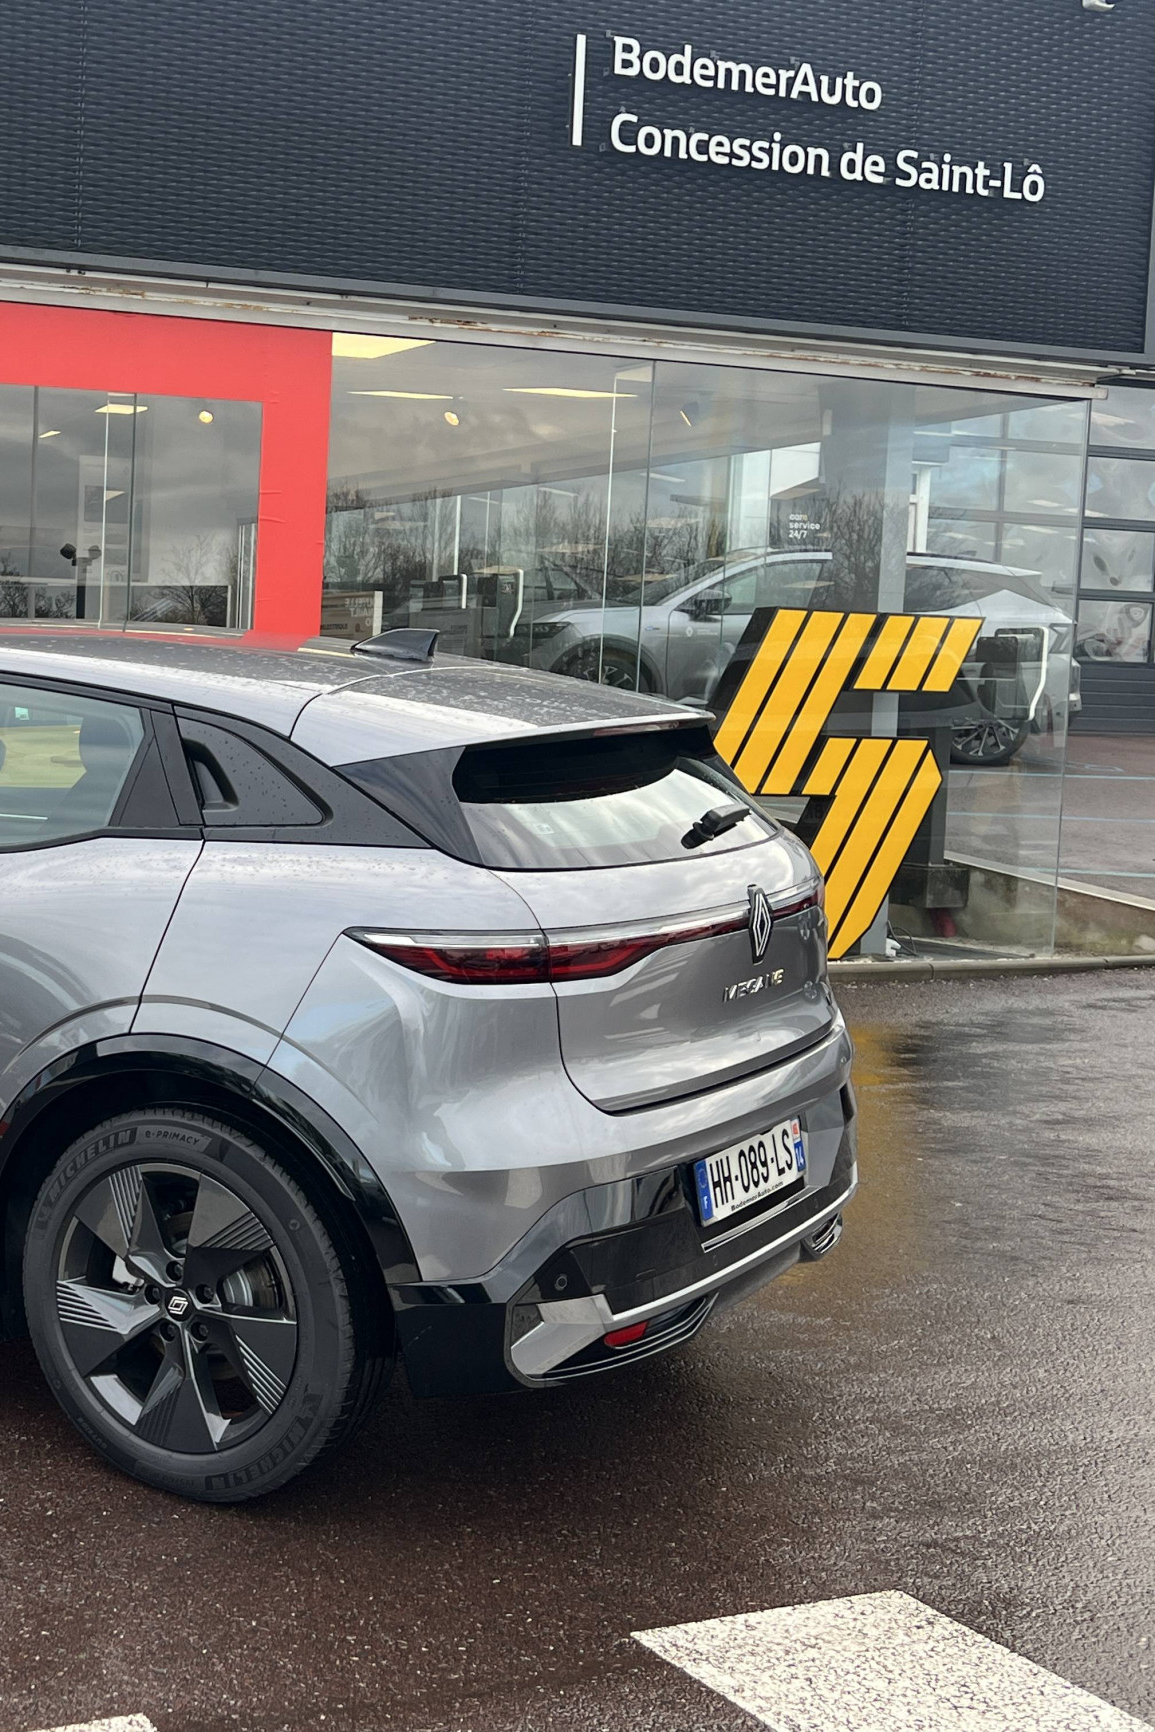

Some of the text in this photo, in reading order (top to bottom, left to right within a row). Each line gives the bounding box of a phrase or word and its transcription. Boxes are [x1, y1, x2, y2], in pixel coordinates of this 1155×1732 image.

[612, 35, 883, 111] BodemerAuto
[609, 112, 1046, 203] Concession de Saint-Lô
[788, 529, 807, 539] 24/7
[789, 521, 821, 530] service
[48, 1129, 132, 1203] MICHELIN
[709, 1128, 793, 1209] HH-089-LS
[795, 1145, 804, 1167] 14
[731, 1181, 784, 1212] BodemerAuto.com
